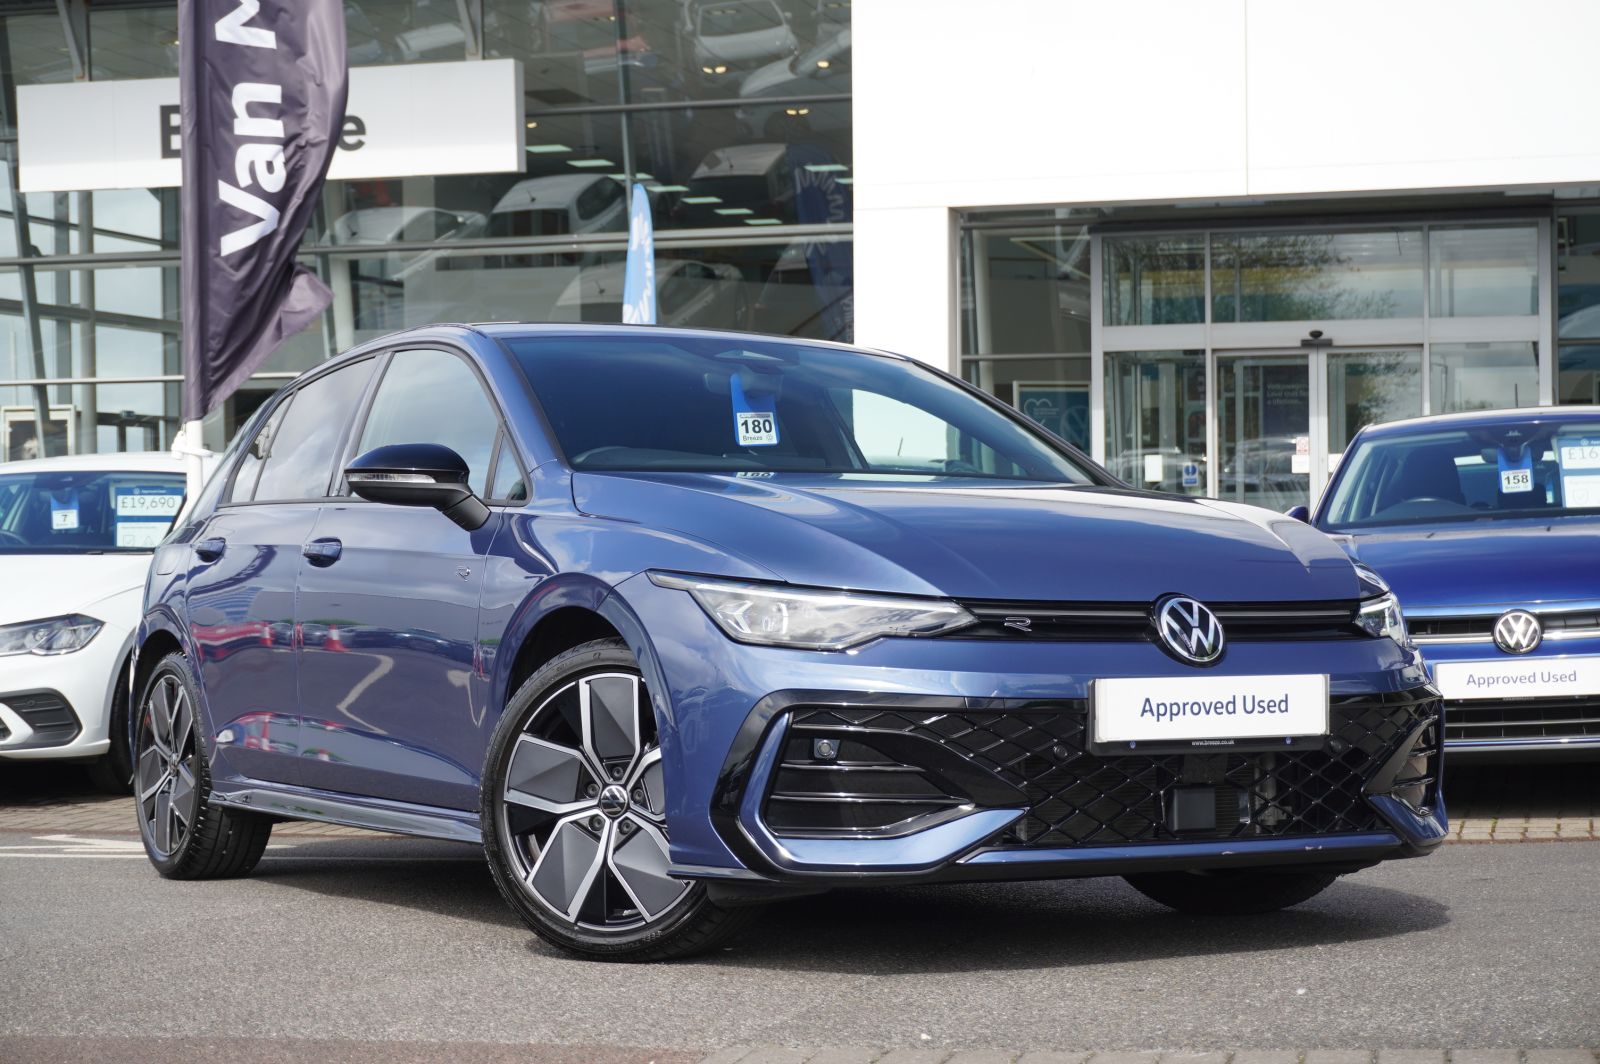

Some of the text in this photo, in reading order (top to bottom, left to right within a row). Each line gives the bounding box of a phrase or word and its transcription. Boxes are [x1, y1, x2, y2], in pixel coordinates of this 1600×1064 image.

[217, 82, 287, 257] Van
[741, 419, 773, 434] 180
[1504, 474, 1529, 485] 158
[121, 496, 176, 510] £19,690
[1466, 670, 1577, 688] Approved Used
[1140, 693, 1289, 722] Approved Used
